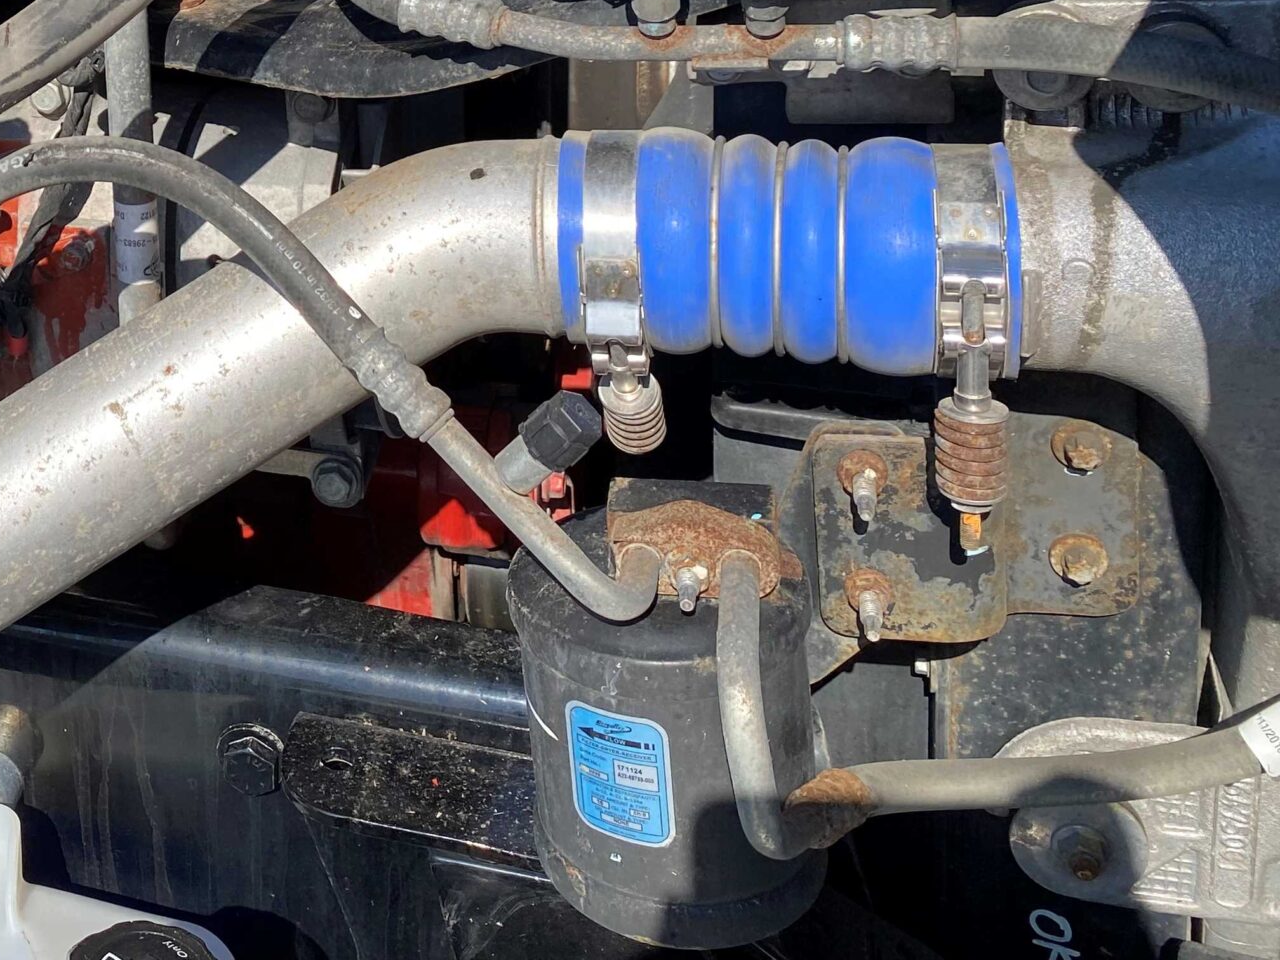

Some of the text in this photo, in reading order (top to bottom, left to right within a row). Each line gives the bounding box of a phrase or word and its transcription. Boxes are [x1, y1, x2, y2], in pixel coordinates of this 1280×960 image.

[605, 735, 626, 746] FLOW
[616, 764, 643, 775] 171124
[162, 940, 188, 958] Only
